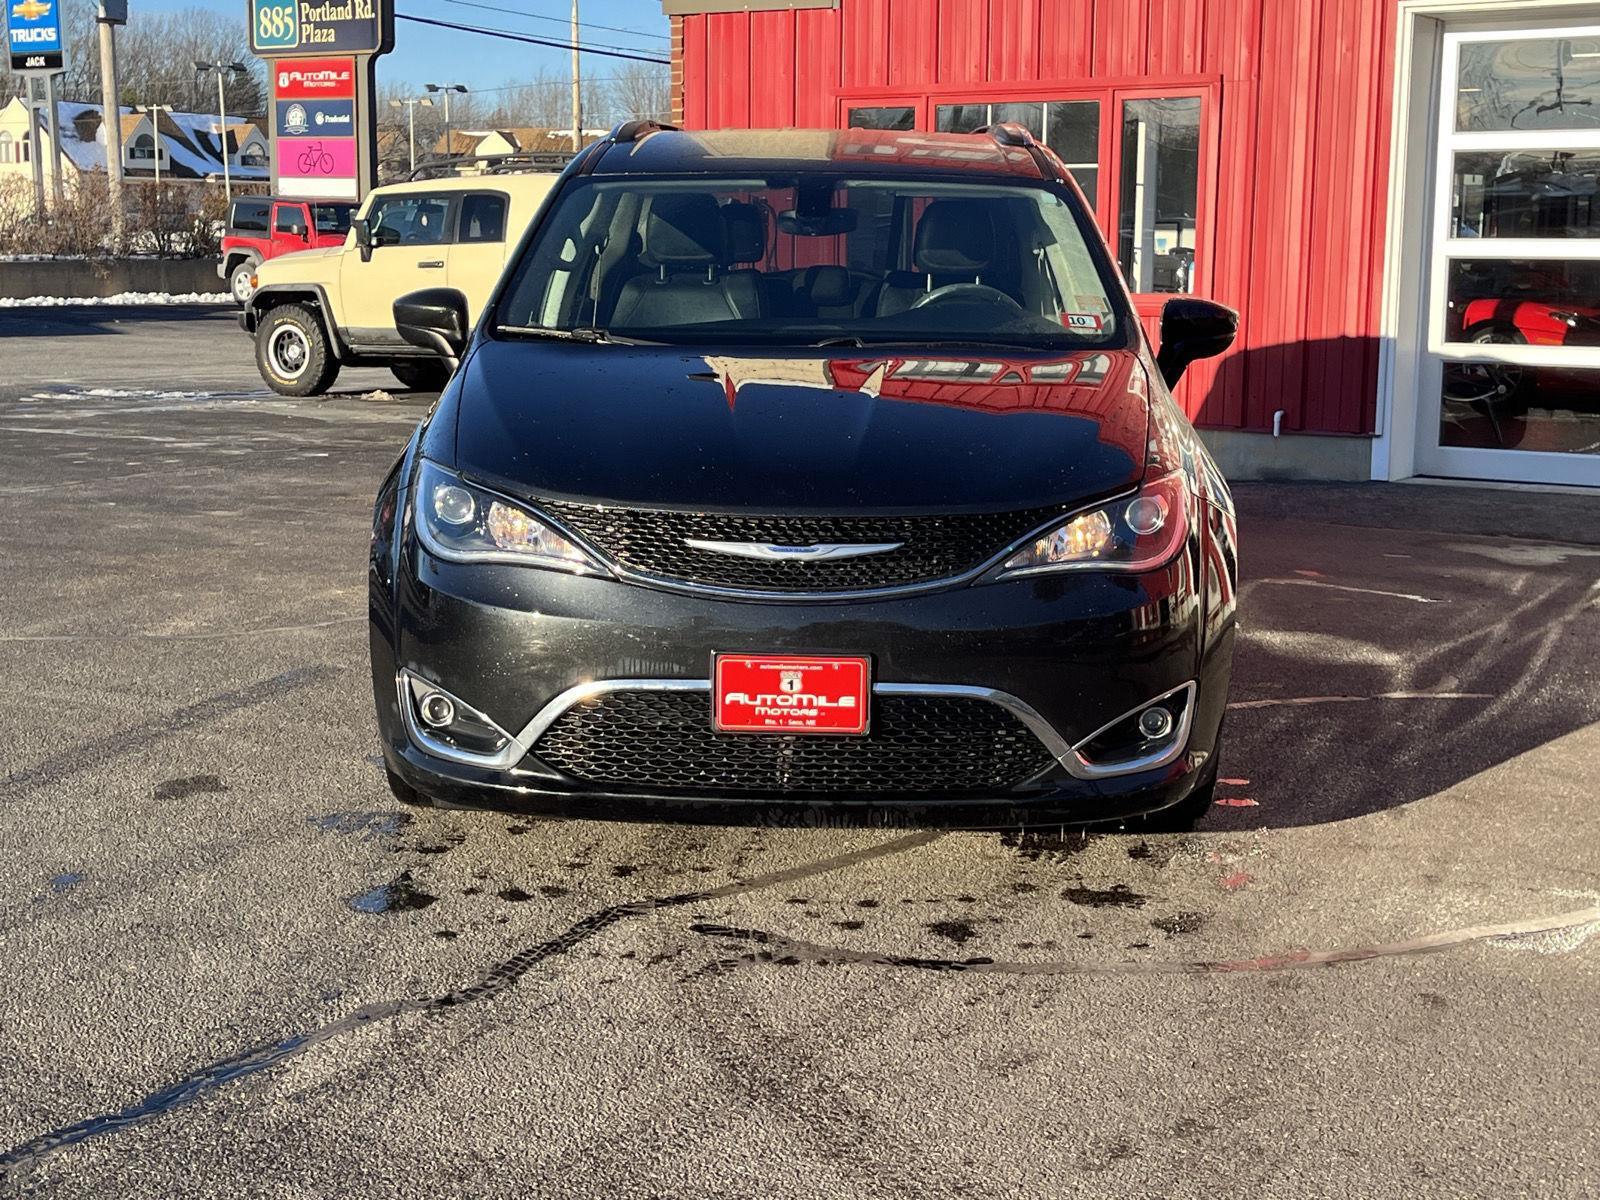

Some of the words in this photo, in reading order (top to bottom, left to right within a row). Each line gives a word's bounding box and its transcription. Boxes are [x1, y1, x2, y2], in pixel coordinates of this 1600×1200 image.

[300, 1, 353, 22] Portland
[355, 0, 376, 19] Rd.
[260, 6, 294, 40] 885
[10, 27, 57, 43] TRUCKS
[301, 24, 336, 44] Plaza
[25, 56, 46, 67] JACK
[1069, 316, 1086, 325] 10
[787, 679, 794, 691] 1
[725, 692, 856, 707] AUTOMILE
[755, 706, 818, 716] MOTORS
